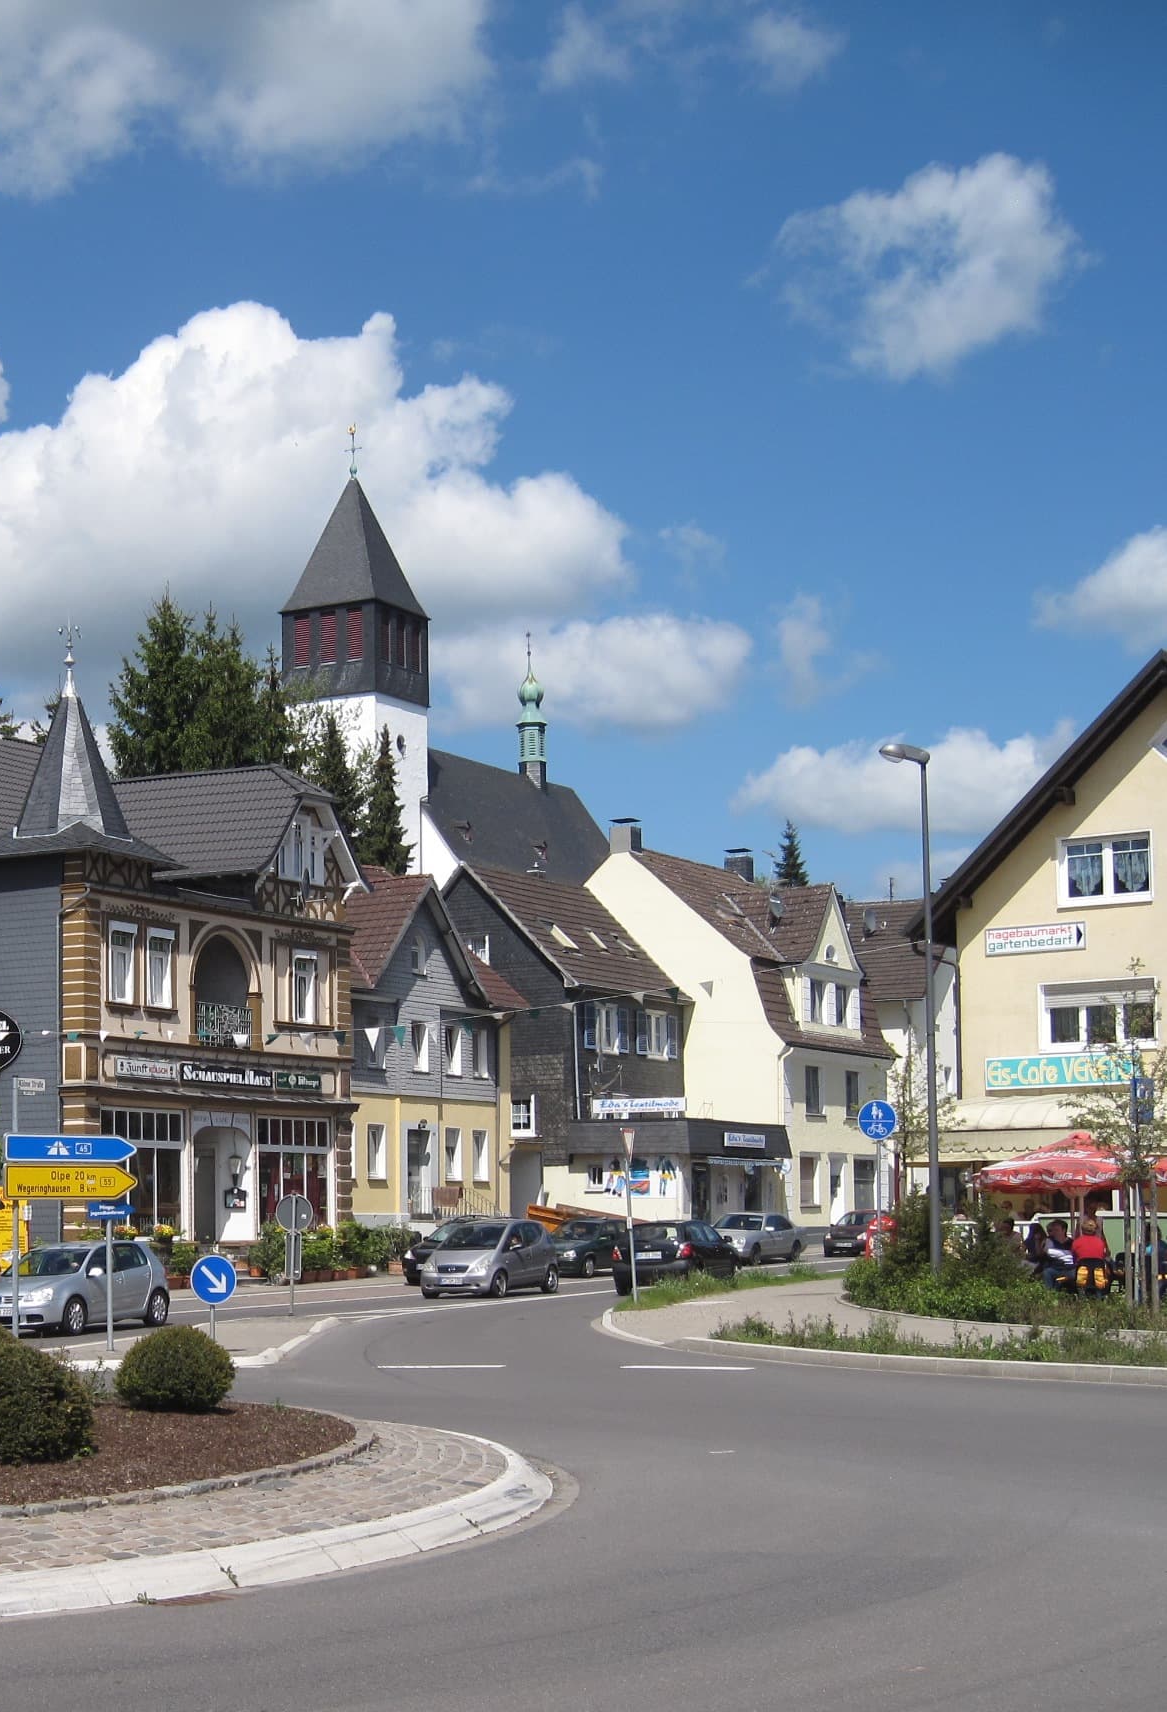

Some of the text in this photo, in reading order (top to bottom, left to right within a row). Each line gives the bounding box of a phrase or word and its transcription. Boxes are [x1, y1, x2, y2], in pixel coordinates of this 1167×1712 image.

[987, 925, 1073, 940] hagebaumarkt
[988, 935, 1074, 952] gartenbedarf
[50, 1171, 71, 1182] Olpe
[74, 1171, 85, 1181] 20
[16, 1183, 71, 1195] Wegeringhausen
[79, 1184, 85, 1193] 8
